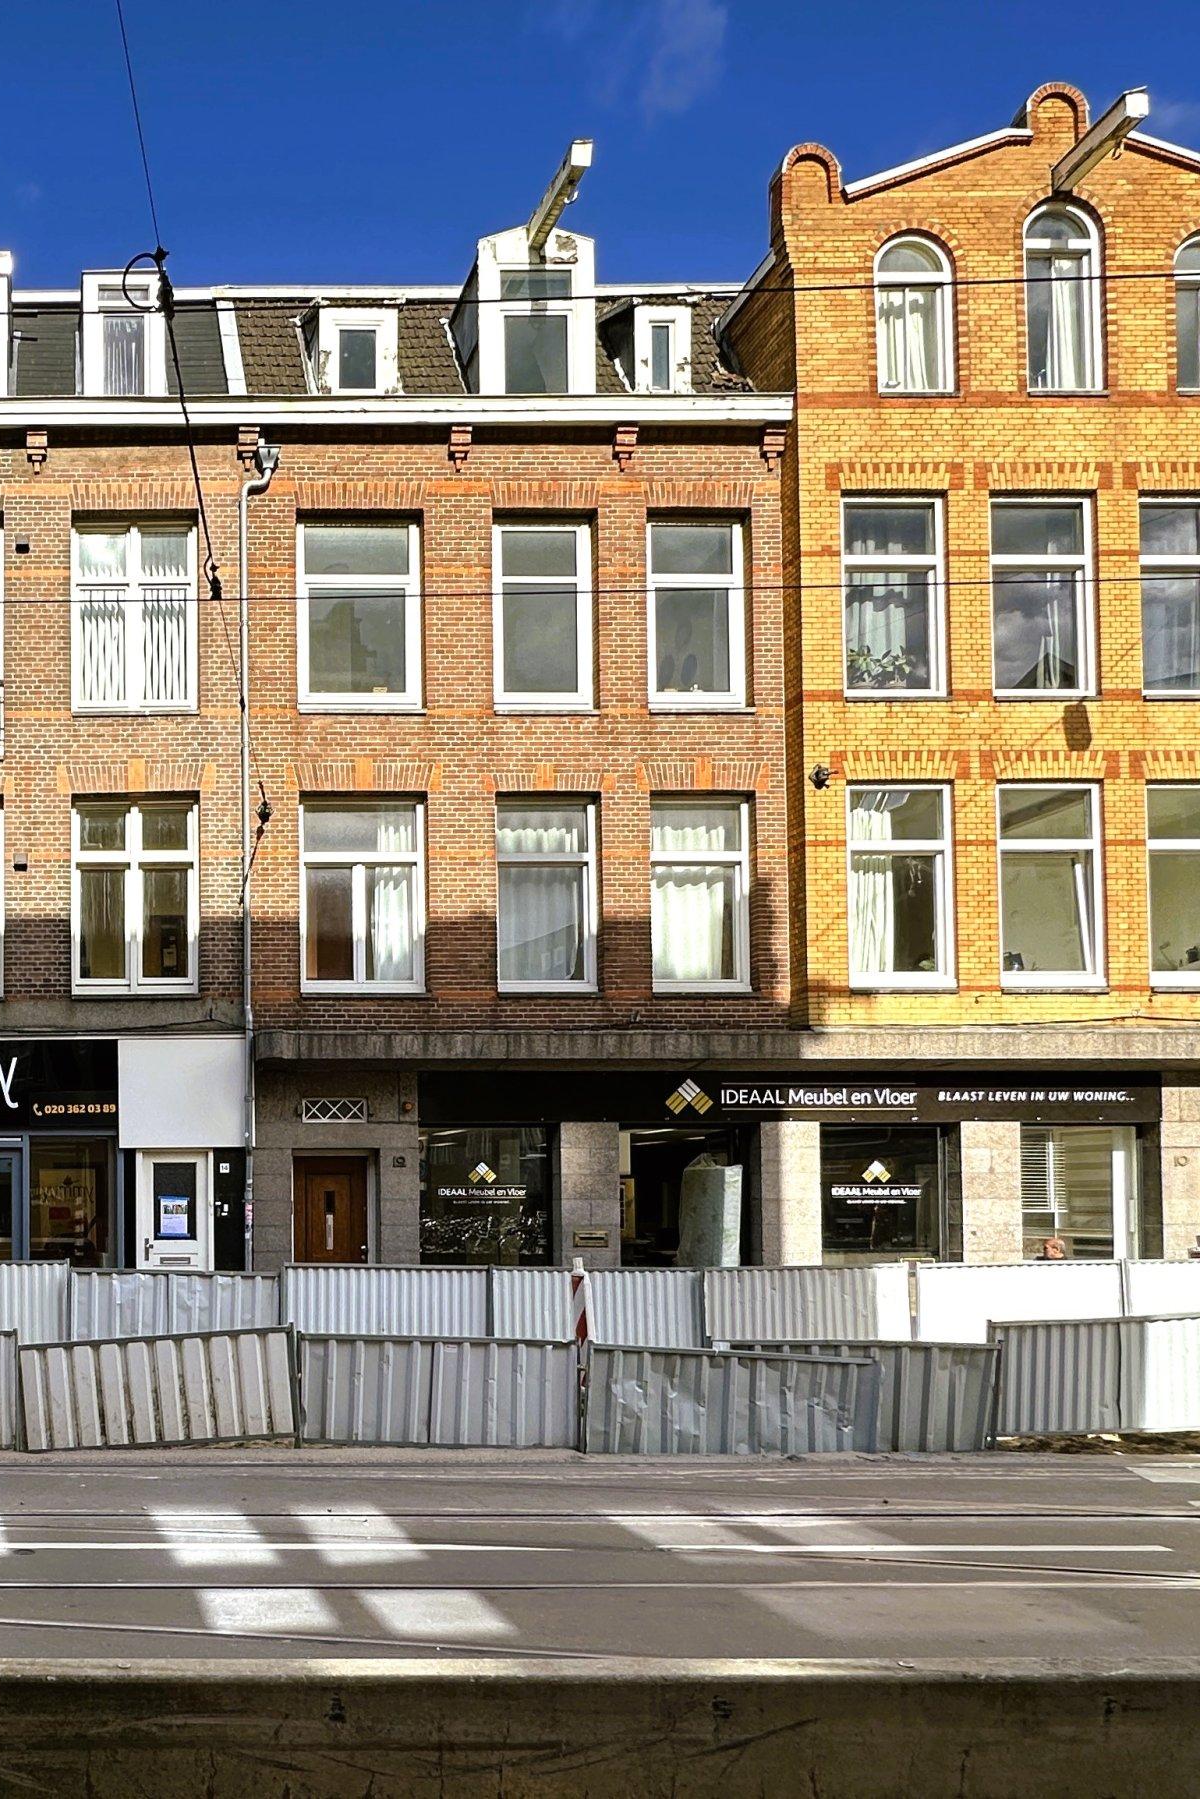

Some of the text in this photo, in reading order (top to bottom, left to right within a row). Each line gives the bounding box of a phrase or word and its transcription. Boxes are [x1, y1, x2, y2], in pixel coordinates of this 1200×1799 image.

[720, 1087, 918, 1105] IDEAAL Meubel en Vloer
[937, 1091, 985, 1102] BLAAST
[987, 1091, 1028, 1102] LEVEN
[1030, 1091, 1046, 1102] IN
[1048, 1091, 1070, 1102] UW
[44, 1103, 116, 1114] 020 362 03 89
[437, 1187, 467, 1196] IDEAAL
[468, 1187, 496, 1196] Meubel
[507, 1187, 527, 1196] Vloer
[831, 1186, 861, 1196] IDEAAL
